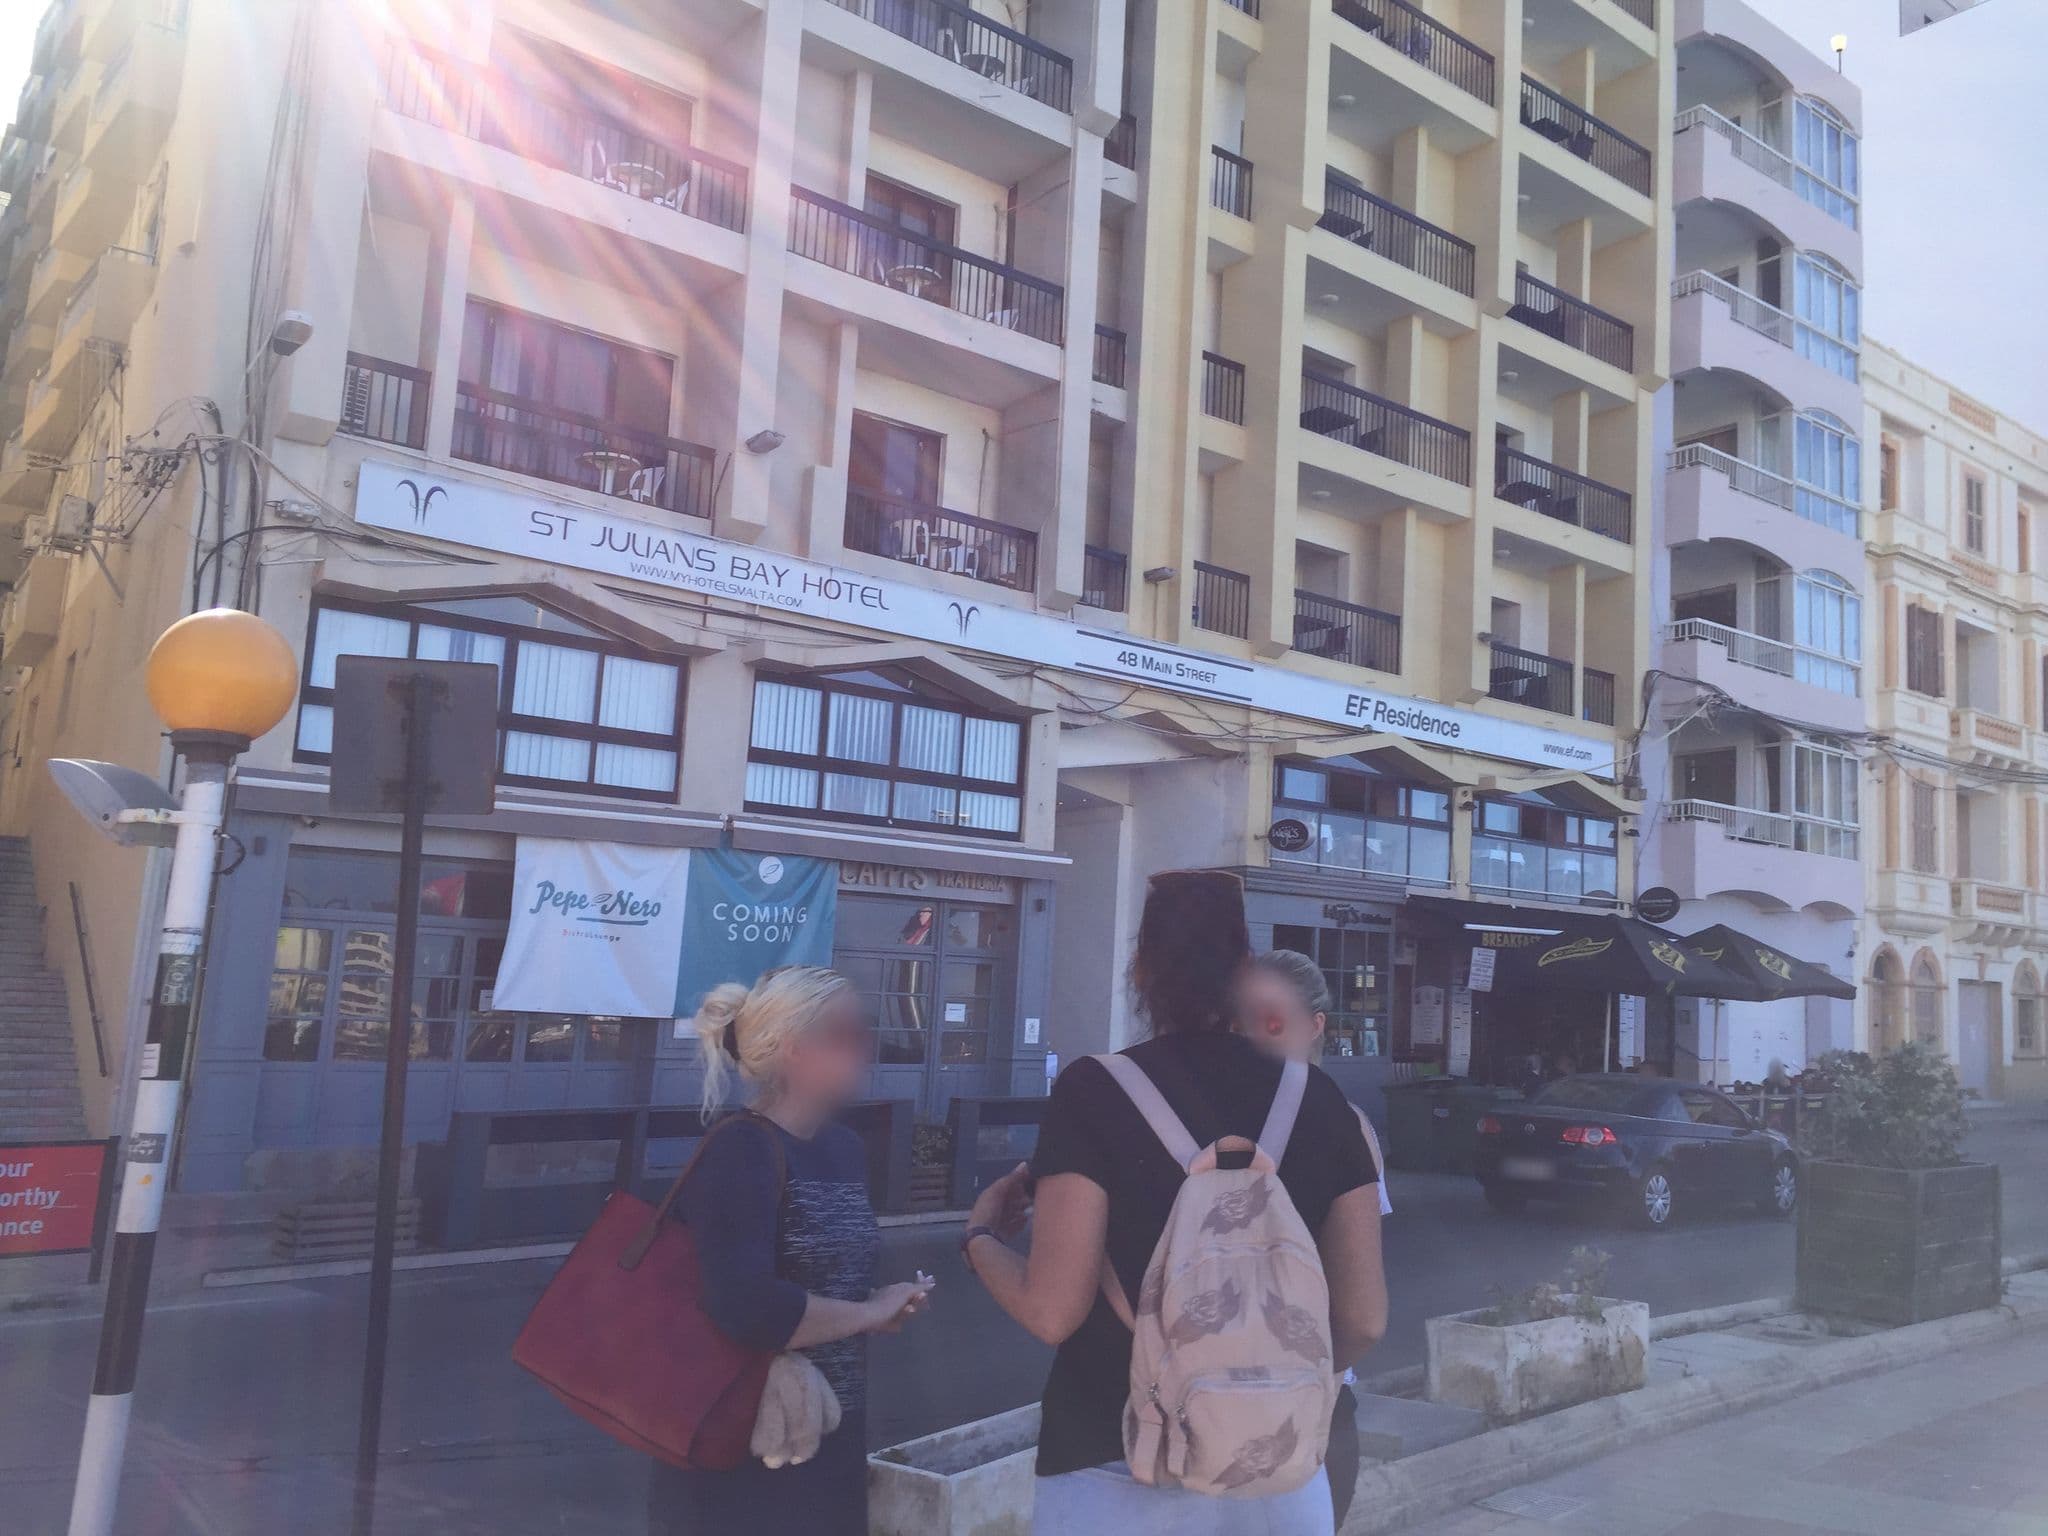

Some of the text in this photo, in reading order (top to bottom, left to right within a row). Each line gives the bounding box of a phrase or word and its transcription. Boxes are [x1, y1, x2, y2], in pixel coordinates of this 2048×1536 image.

[528, 509, 890, 612] ST JULIANS BAY HOTEL
[1117, 650, 1138, 668] 48
[1344, 693, 1461, 740] EF Residence
[1543, 743, 1593, 762] www.ef.com
[529, 880, 662, 918] Pepe Nero
[712, 902, 808, 923] COMING
[727, 924, 795, 943] SOON
[0, 1219, 44, 1236] nce
